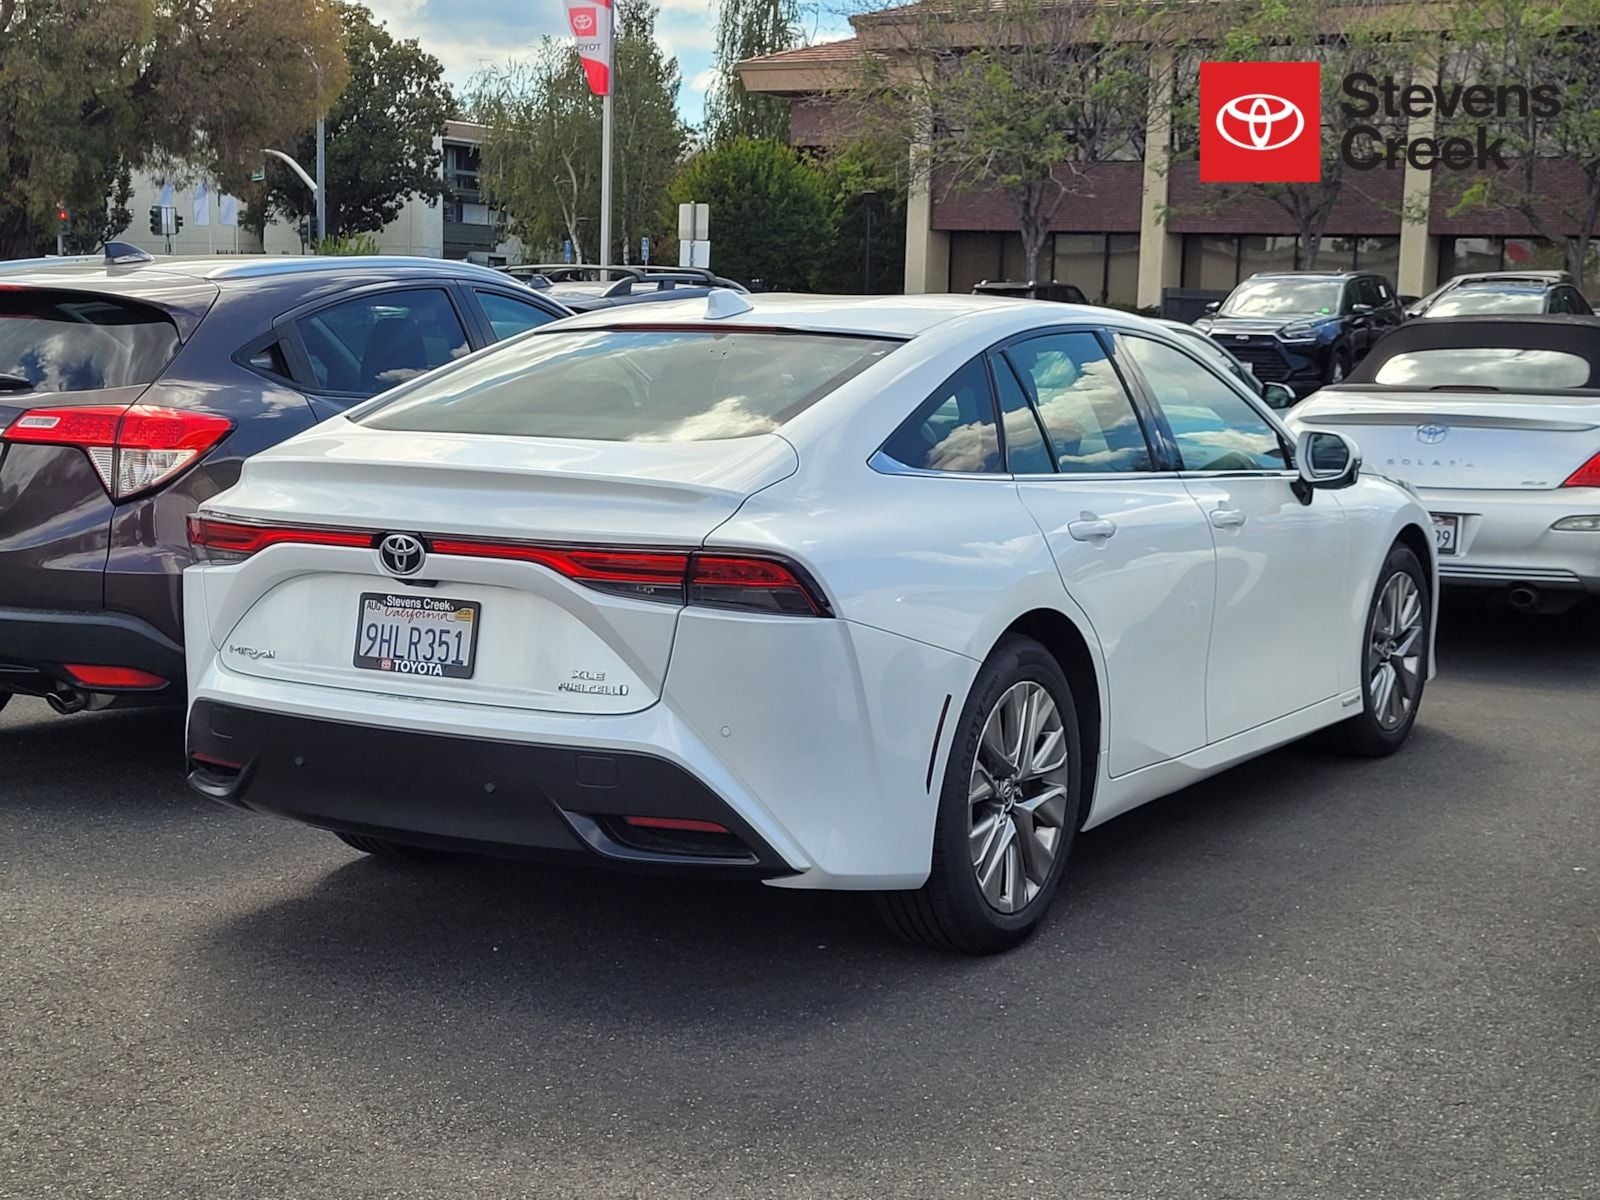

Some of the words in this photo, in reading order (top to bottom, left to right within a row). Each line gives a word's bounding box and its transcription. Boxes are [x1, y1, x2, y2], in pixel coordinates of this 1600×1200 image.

[386, 595, 421, 606] Stevens
[423, 598, 450, 611] Creek
[385, 606, 455, 624] California
[363, 623, 464, 665] 9HLR351
[394, 660, 443, 676] TOYOTA
[571, 669, 606, 681] XLE
